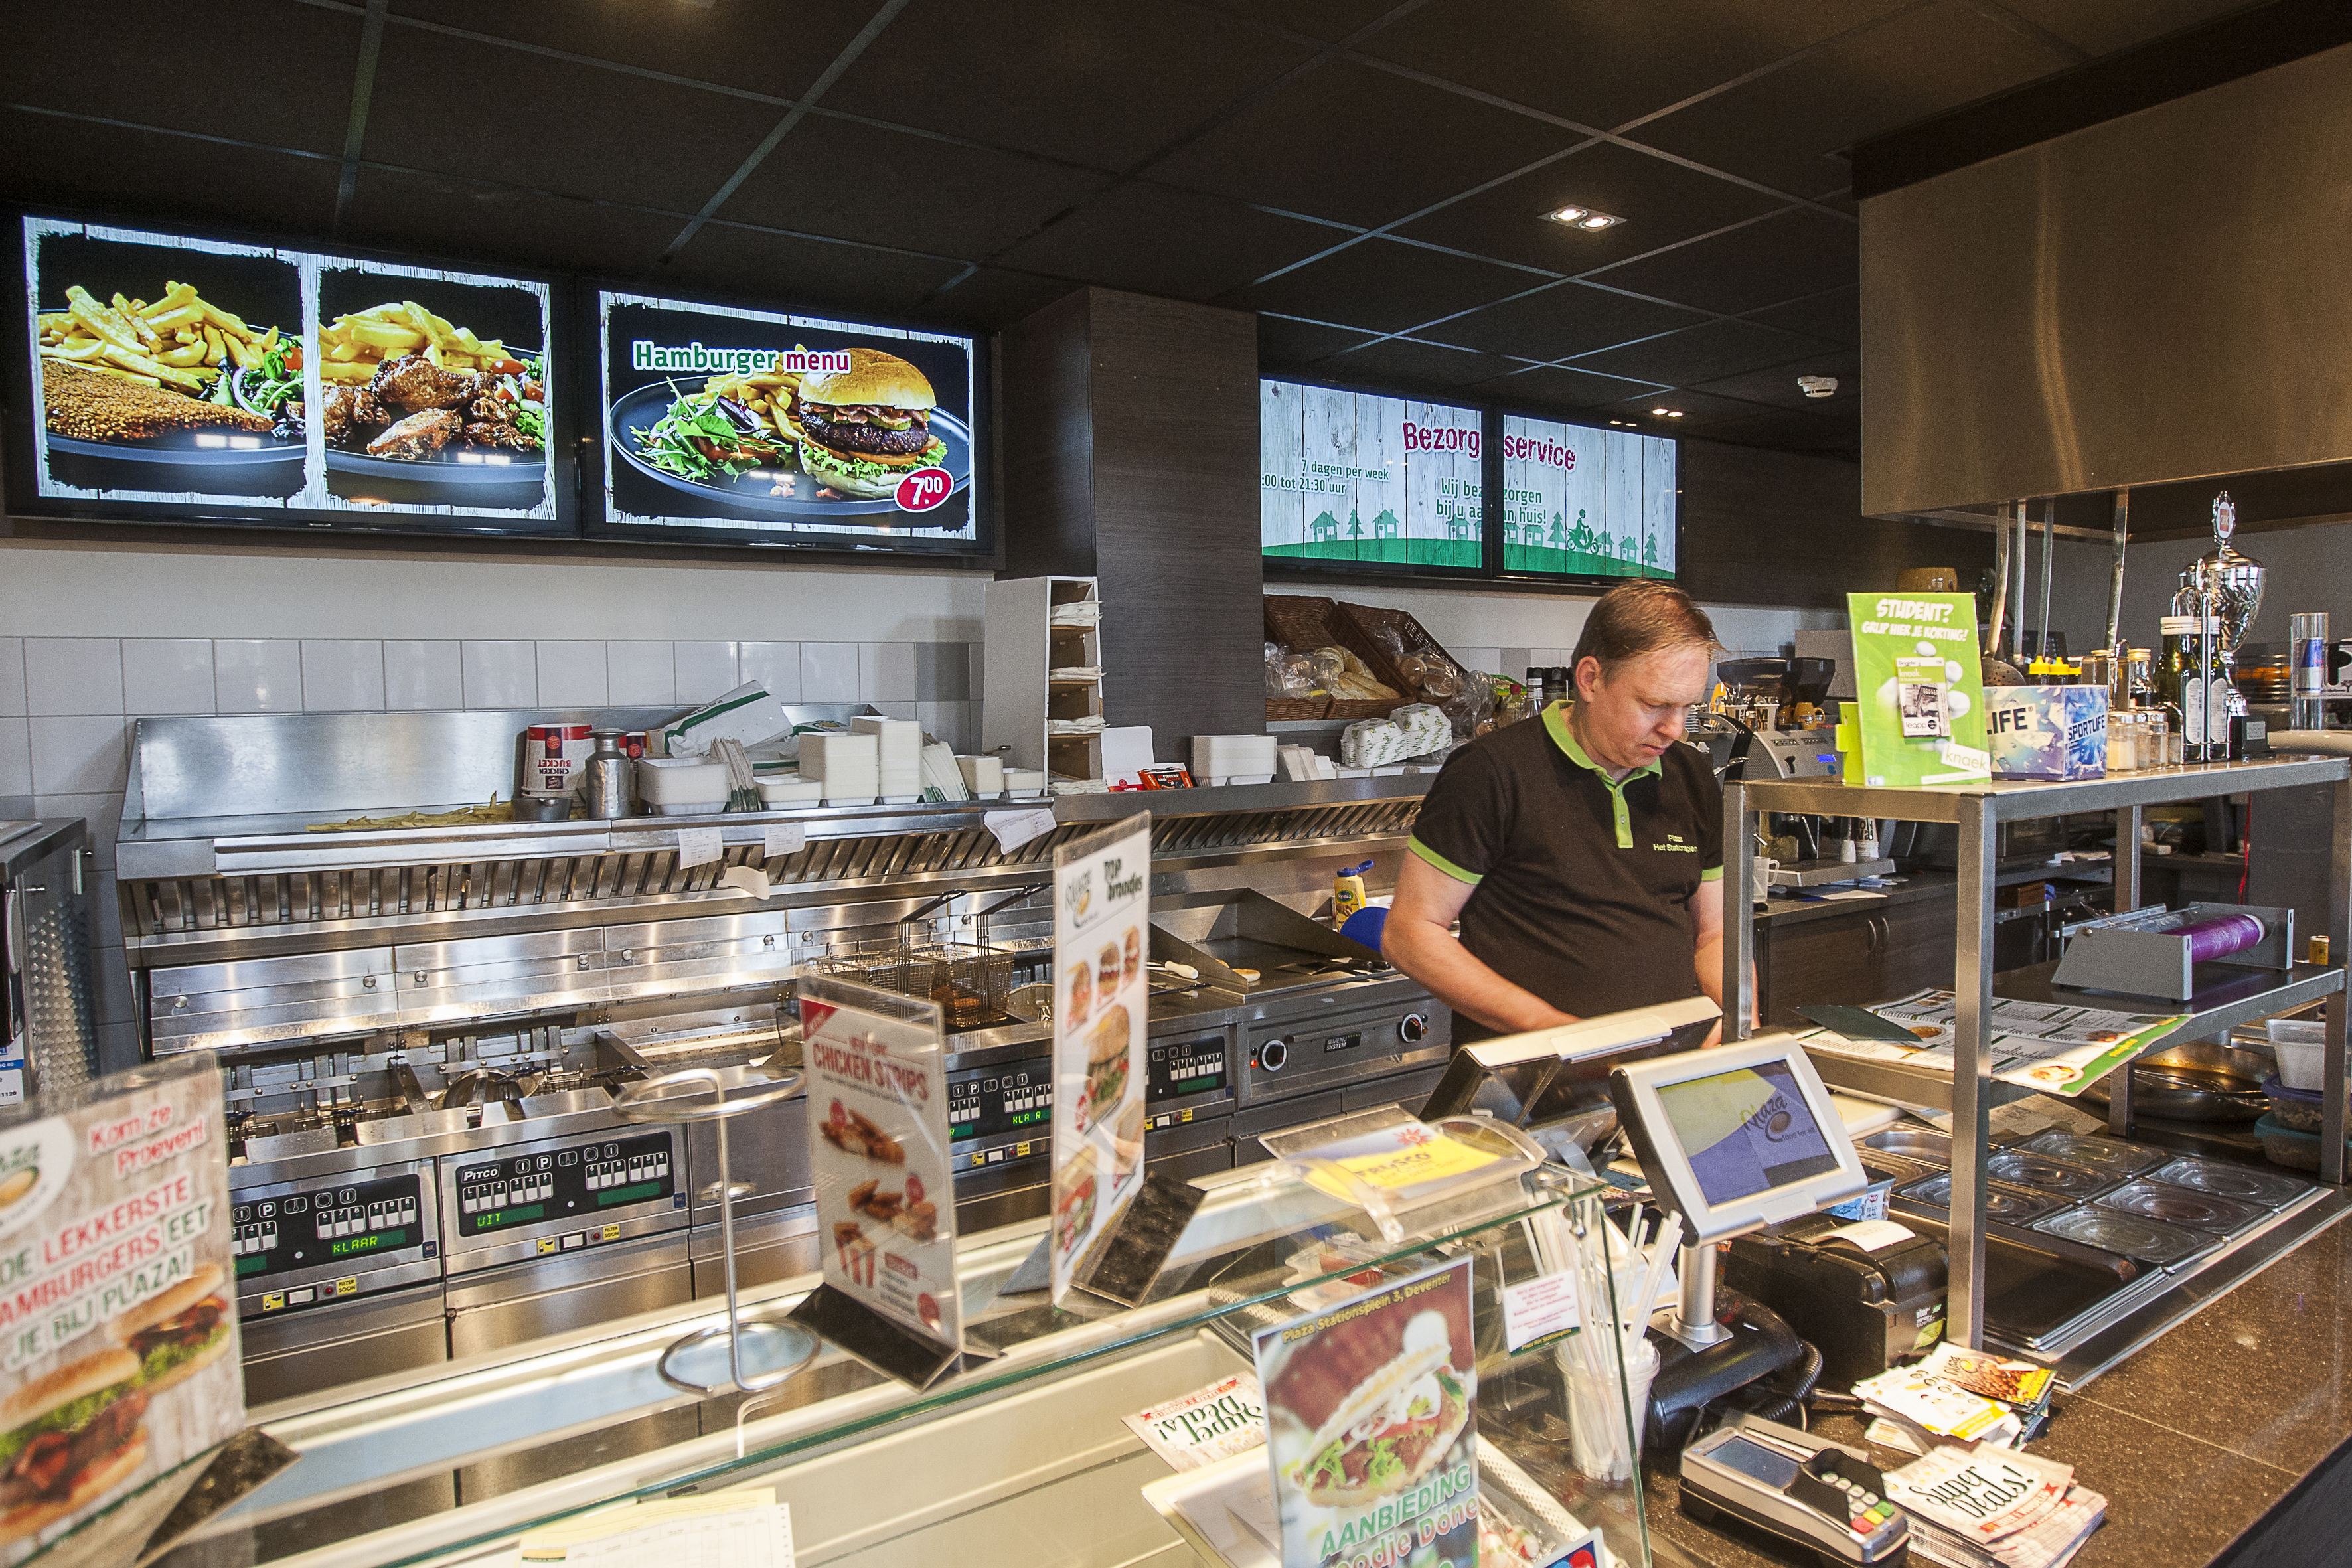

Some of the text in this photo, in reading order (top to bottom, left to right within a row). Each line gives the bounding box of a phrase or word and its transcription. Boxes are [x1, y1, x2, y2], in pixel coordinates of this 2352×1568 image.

[635, 342, 848, 373] Hamburger menu
[1403, 422, 1577, 471] Bezorg service
[1302, 459, 1389, 480] 7 dagen per week
[1281, 476, 1296, 489] tot
[1299, 477, 1326, 492] 21:30
[1328, 482, 1345, 495] uur
[1441, 479, 1458, 500] Wij
[1437, 500, 1454, 520] bij
[1456, 507, 1464, 517] u
[1519, 509, 1547, 525] huis!
[1876, 598, 1954, 623] STUDENT?
[1890, 623, 1911, 636] HIER
[1911, 626, 1922, 637] JE
[1923, 626, 1970, 641] KORTING!
[1986, 707, 2028, 735] IFE
[2068, 714, 2106, 741] SPORTLIFE
[537, 759, 572, 768] BUCKET
[1946, 746, 1990, 772] knaek.
[1326, 1042, 1346, 1051] SYSTEM
[812, 1042, 872, 1083] CHICKEN
[874, 1060, 929, 1101] STRIPS
[1740, 1095, 1788, 1132] Plaza
[90, 1105, 171, 1152] Kom ze
[116, 1119, 206, 1175] Proeven!
[463, 1168, 499, 1182] PITCO
[540, 1158, 548, 1168] P
[42, 1175, 190, 1265] LEKKERSTE
[263, 1205, 273, 1216] P
[477, 1212, 501, 1227] UIT
[333, 1235, 378, 1254] KLAAR
[0, 1204, 208, 1326] AMBURGERS EET
[52, 1299, 92, 1341] BIJ
[102, 1250, 187, 1316] PLAZA!
[338, 1284, 356, 1293] SOON
[1281, 1323, 1316, 1344] Plaza
[1317, 1295, 1391, 1330] Stationsplein
[1403, 1272, 1452, 1299] Deventer
[1194, 1390, 1221, 1403] LEKKER
[1149, 1402, 1188, 1419] VOORDELIG
[1152, 1394, 1245, 1443] Deals!
[1190, 1402, 1266, 1447] Super
[1909, 1466, 1985, 1506] Super
[1945, 1464, 2035, 1519] Deals!
[1319, 1464, 1472, 1563] AANBIEDING
